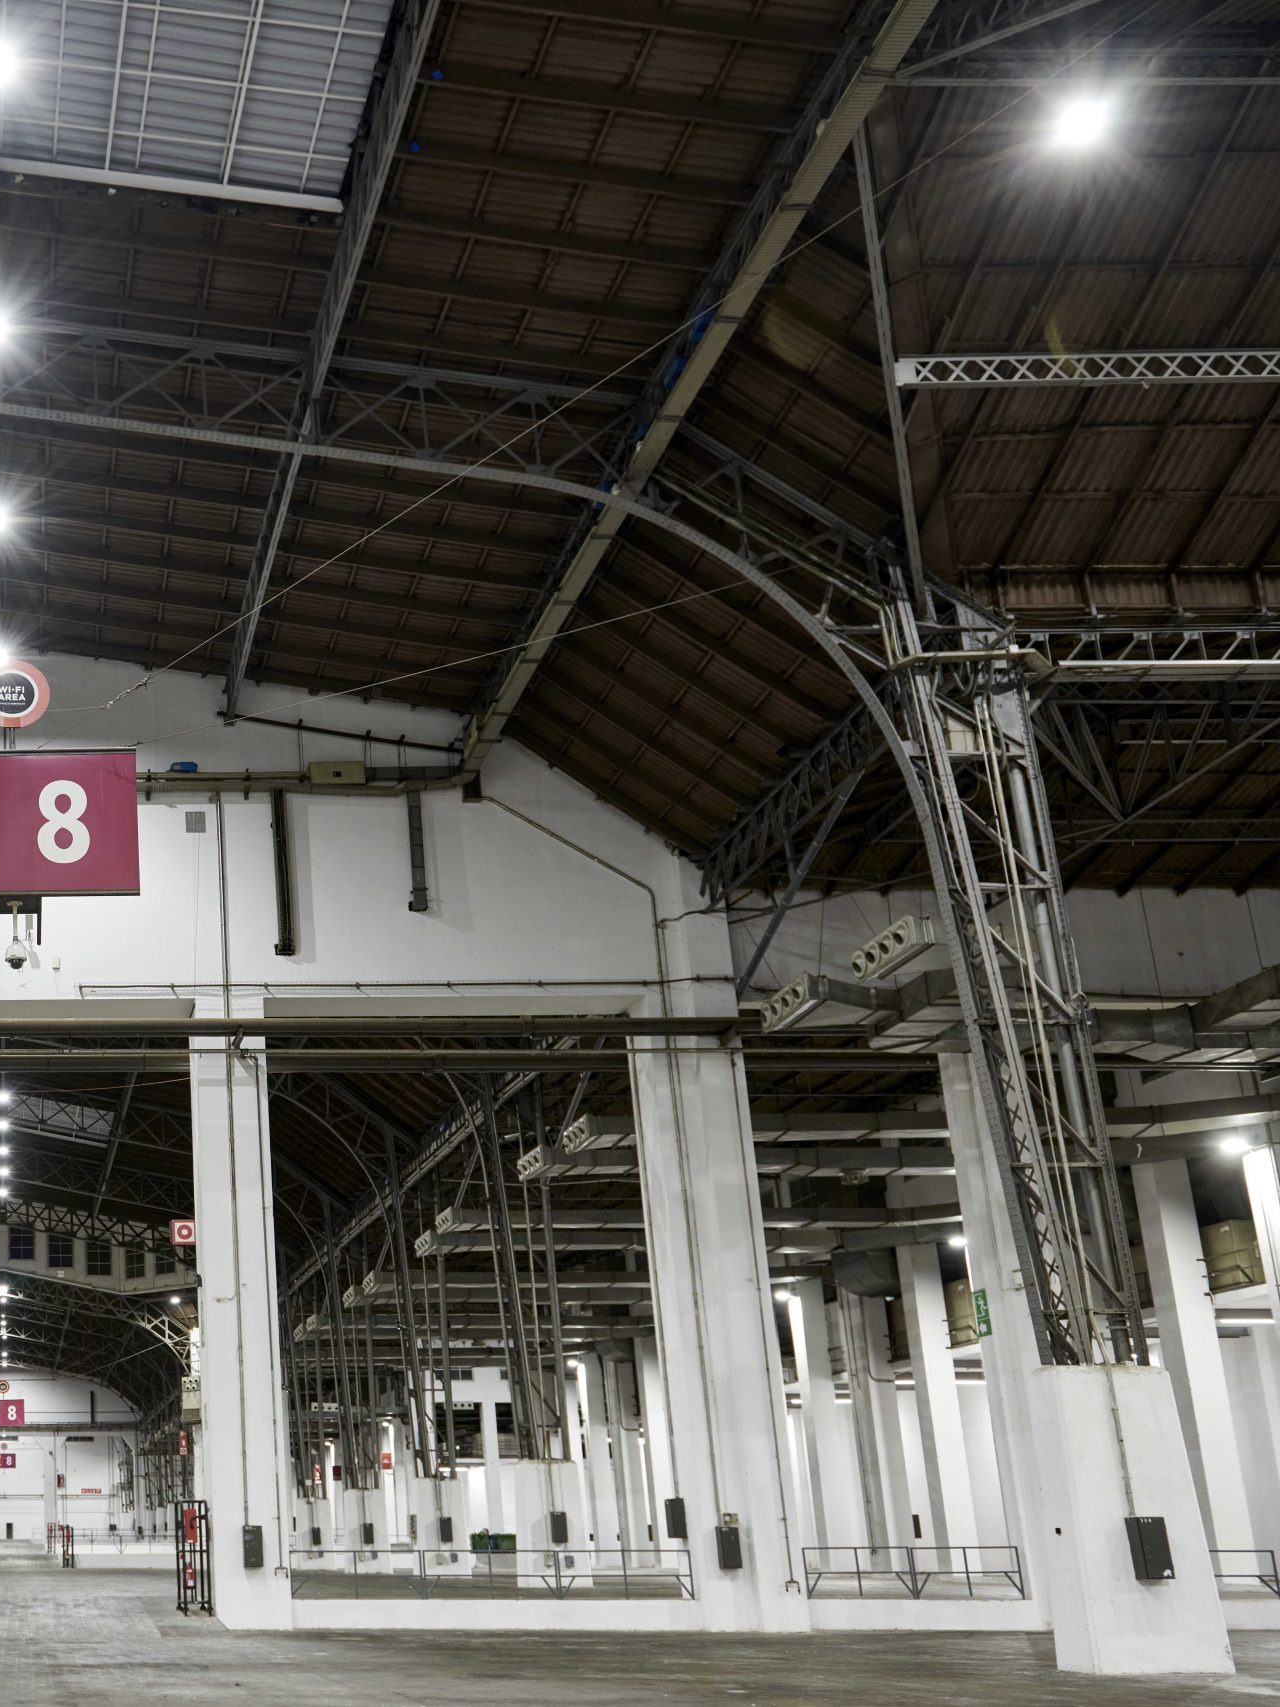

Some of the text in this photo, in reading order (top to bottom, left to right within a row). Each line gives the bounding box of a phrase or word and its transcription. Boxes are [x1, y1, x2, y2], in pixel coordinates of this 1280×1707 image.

[37, 779, 91, 864] 8
[7, 1405, 17, 1421] 8
[6, 1456, 13, 1466] 8
